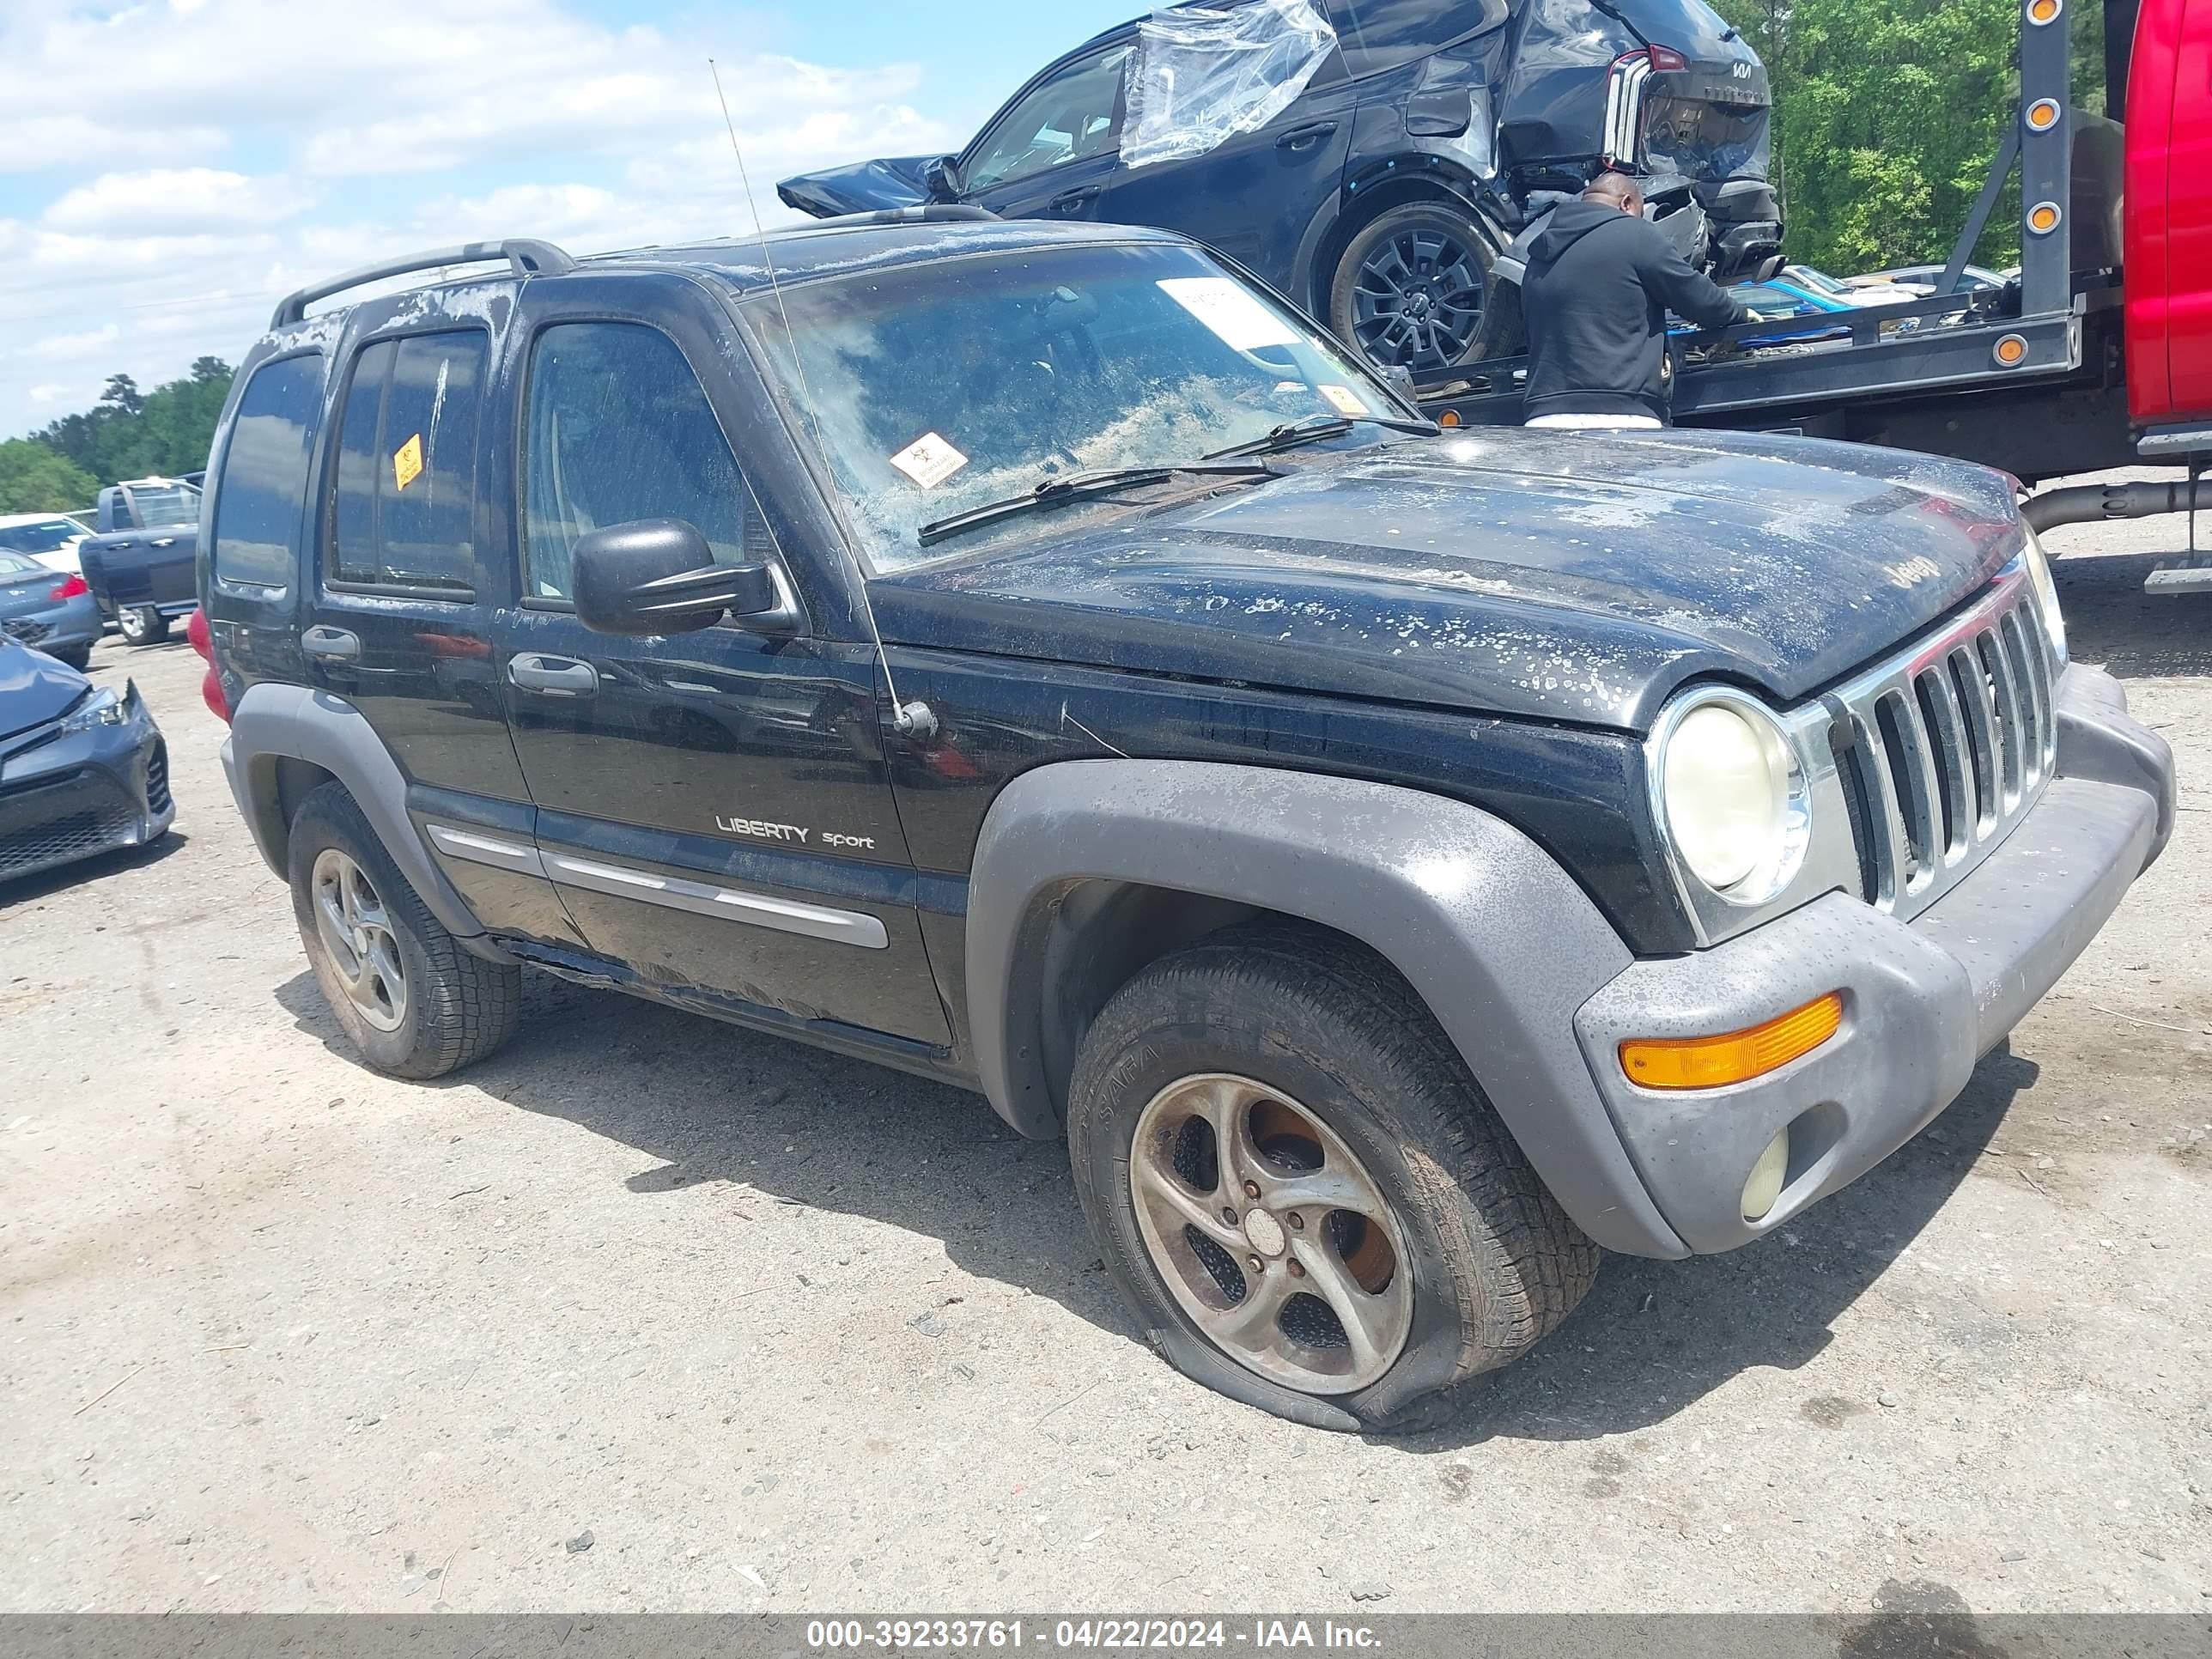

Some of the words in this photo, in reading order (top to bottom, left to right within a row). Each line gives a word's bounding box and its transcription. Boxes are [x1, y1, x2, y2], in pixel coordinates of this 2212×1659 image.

[1882, 556, 1941, 589] Jeep
[715, 815, 810, 843] LIBERTY
[822, 831, 875, 849] sport
